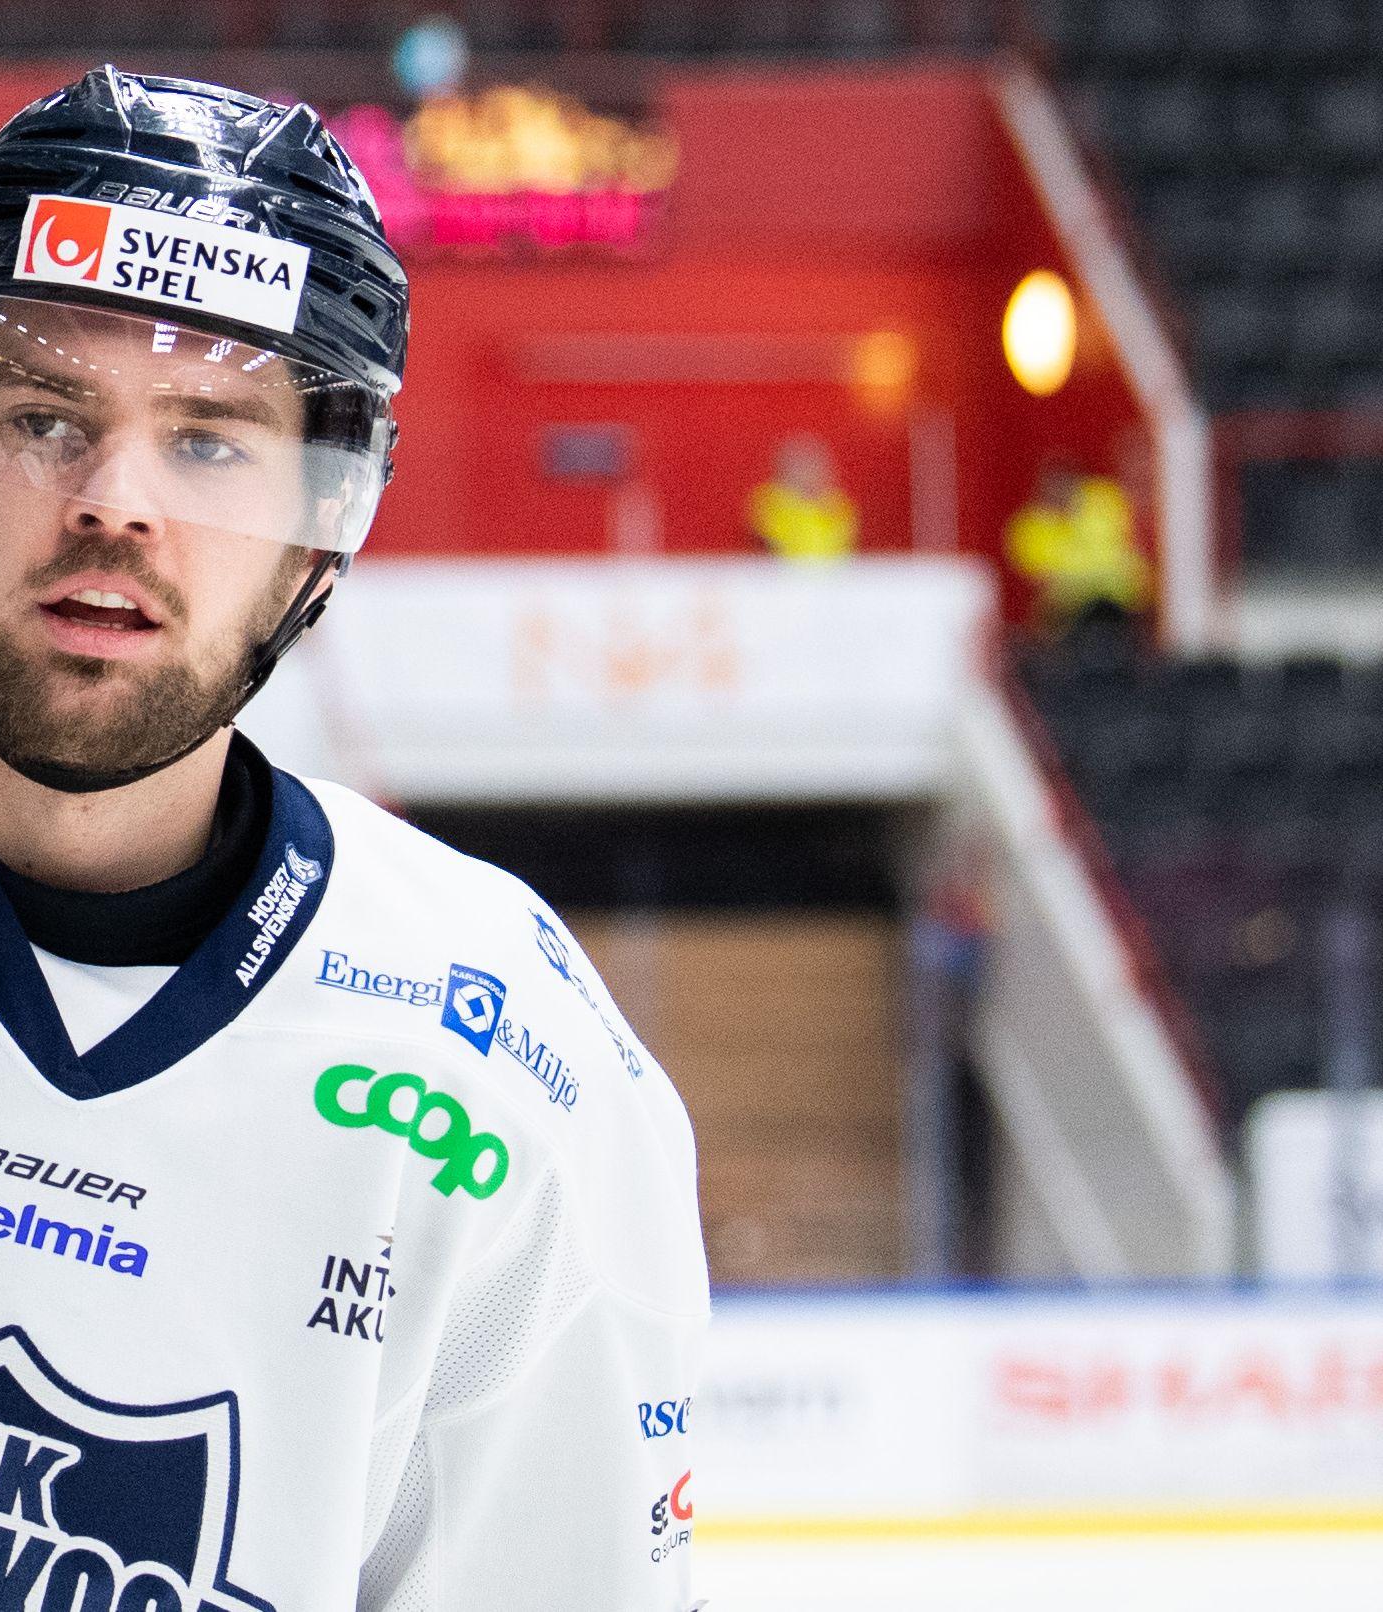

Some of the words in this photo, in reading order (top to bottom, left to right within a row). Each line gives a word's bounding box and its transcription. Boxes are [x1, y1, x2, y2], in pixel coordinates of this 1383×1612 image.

[90, 181, 254, 230] BAUER
[112, 261, 203, 303] SPEL
[119, 227, 291, 290] SVENSKA
[247, 862, 291, 926] HOCKEY
[235, 878, 308, 988] ALLSVENSKAN
[317, 950, 444, 1006] Energi
[314, 1064, 509, 1200] coop
[321, 1254, 396, 1301] INT
